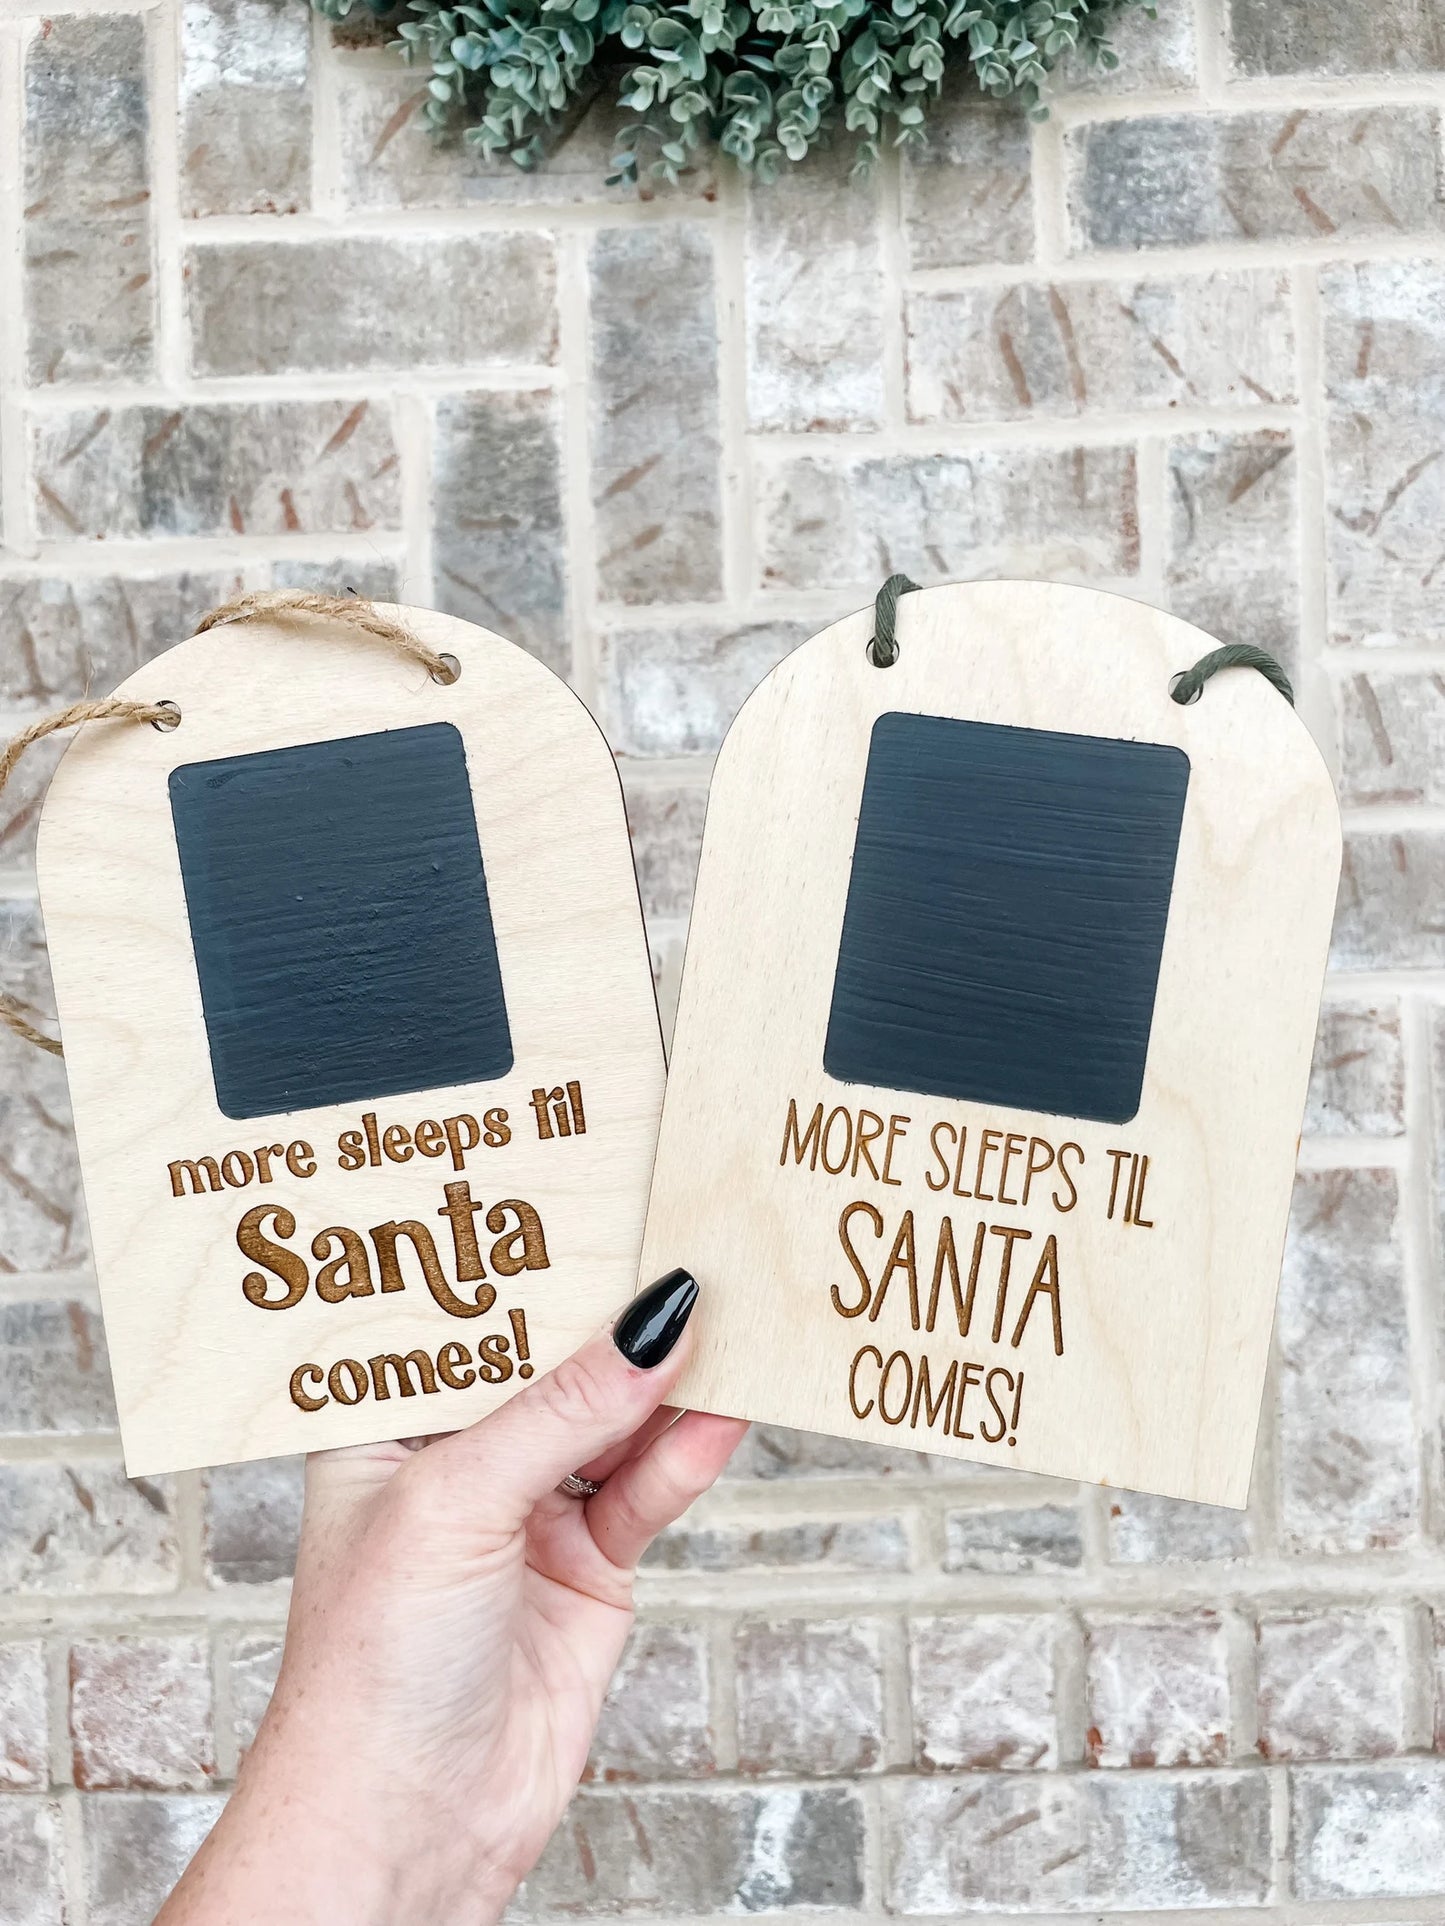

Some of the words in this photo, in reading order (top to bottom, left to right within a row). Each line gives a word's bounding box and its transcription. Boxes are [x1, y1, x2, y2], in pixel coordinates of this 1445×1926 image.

[167, 1139, 315, 1197] more
[338, 1107, 513, 1171] sleeps
[529, 1080, 587, 1140] til
[779, 1098, 911, 1186] MORE
[925, 1121, 1085, 1213] SLEEPS
[1106, 1149, 1154, 1228] TIL
[236, 1180, 551, 1319] Santa
[830, 1200, 1064, 1356] SANTA
[289, 1308, 535, 1412] comes!
[848, 1344, 1024, 1447] COMES!
